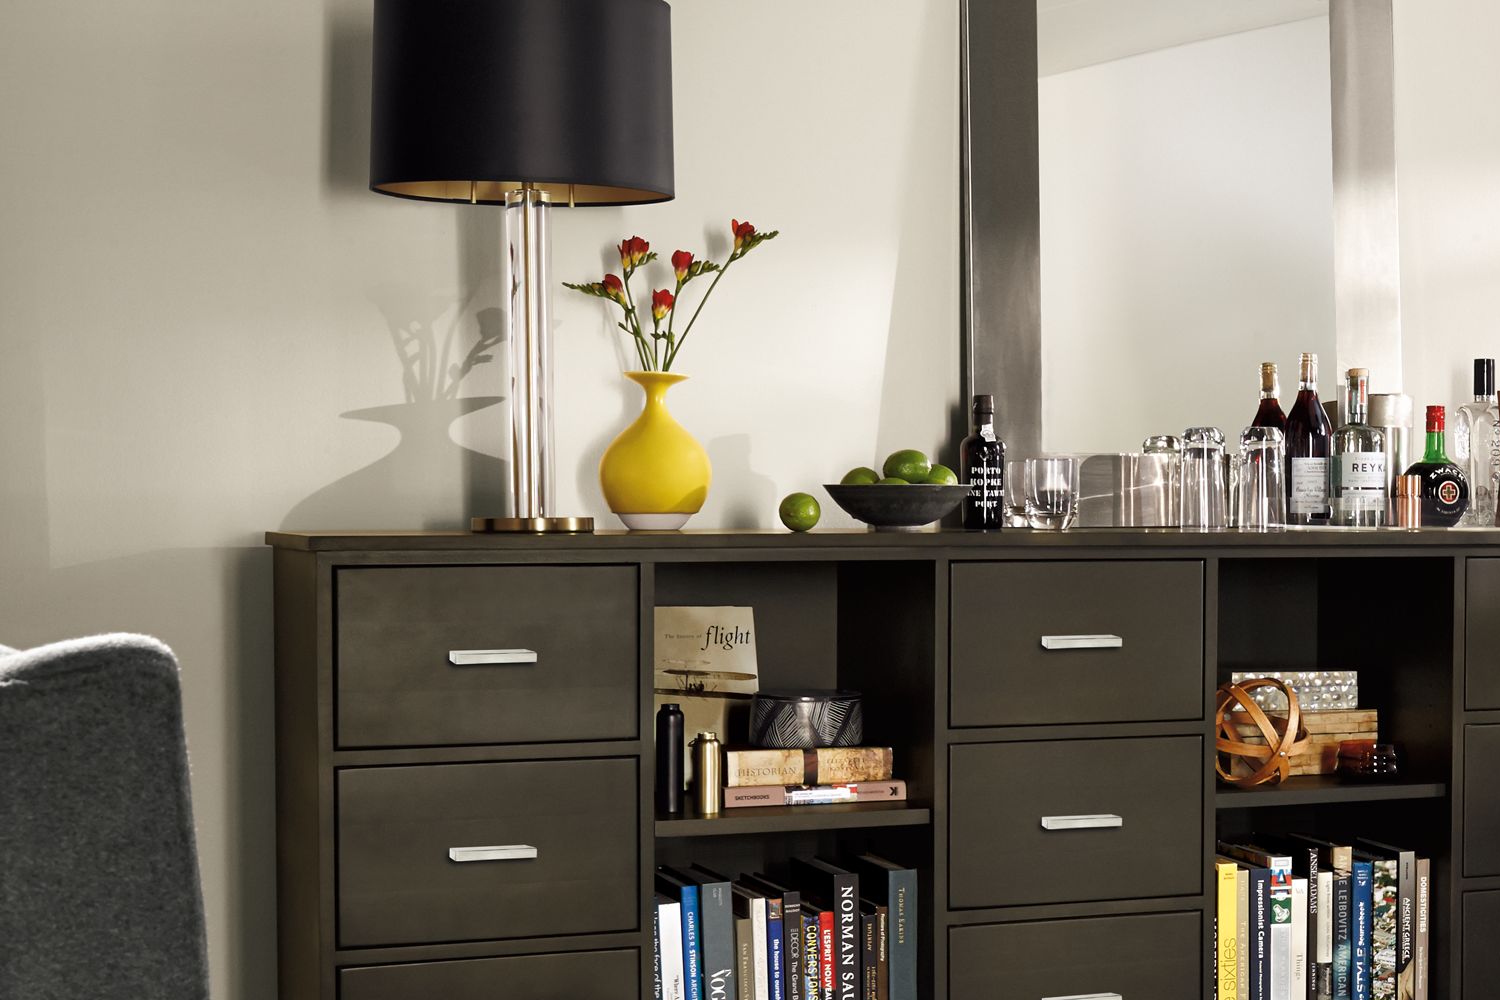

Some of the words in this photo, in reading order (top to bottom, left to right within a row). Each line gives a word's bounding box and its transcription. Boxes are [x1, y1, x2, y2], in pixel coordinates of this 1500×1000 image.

[970, 478, 1001, 486] KOPKE
[1352, 463, 1385, 472] REYK
[1429, 467, 1466, 481] ZWACK
[701, 626, 751, 651] flight
[738, 767, 797, 777] HISTORIAN
[1310, 853, 1318, 882] ANSEL
[1256, 880, 1265, 929] Impressionist
[1338, 889, 1347, 940] LEIBOVITZ
[1403, 898, 1411, 932] ANCIENT
[1420, 876, 1428, 933] DOMESTICITIES
[687, 911, 695, 940] CHARLES
[841, 886, 854, 966] NORMAN
[790, 932, 800, 959] DECOR
[823, 929, 832, 962] L'ESPRIT
[1403, 932, 1411, 959] GREECE
[689, 949, 697, 977] STINSON
[774, 971, 780, 979] to
[1220, 938, 1236, 991] sixties
[1338, 944, 1347, 997] AMERICAN
